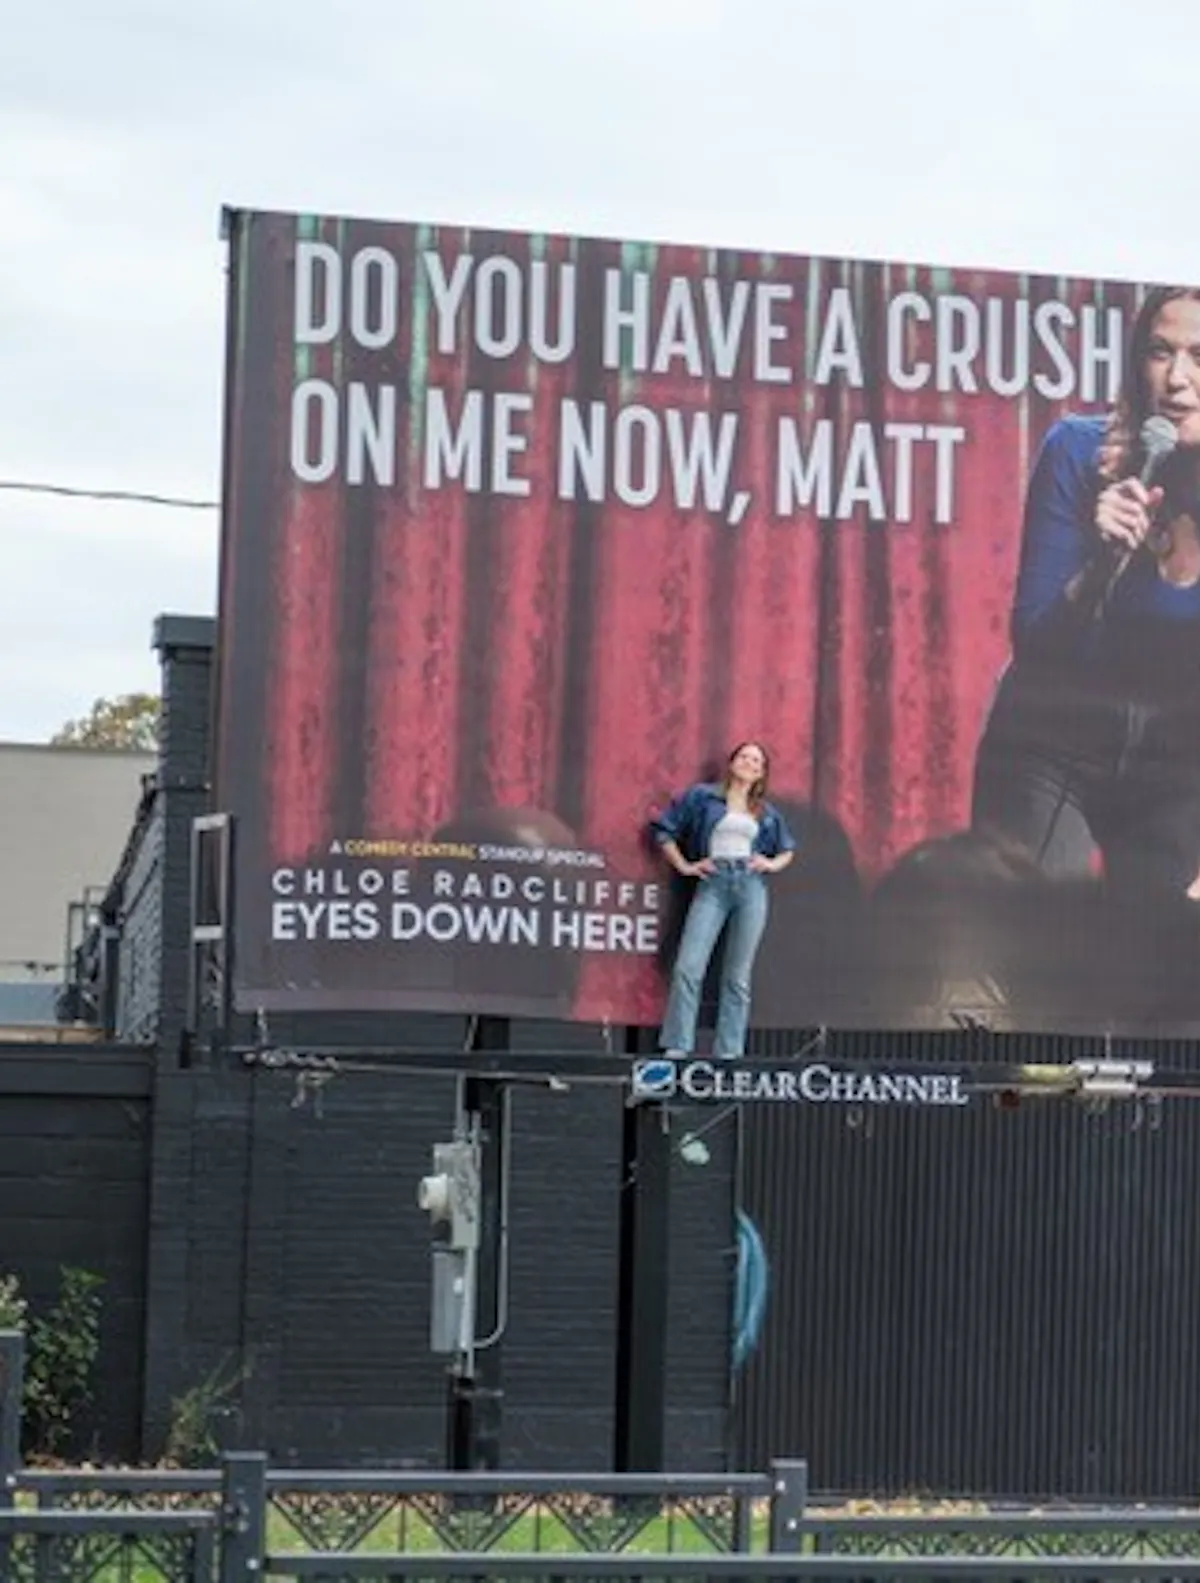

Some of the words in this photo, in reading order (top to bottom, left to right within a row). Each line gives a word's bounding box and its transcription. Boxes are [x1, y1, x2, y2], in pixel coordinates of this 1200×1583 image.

[295, 241, 397, 348] DO
[422, 251, 577, 363] YOU
[604, 269, 792, 381] HAVE
[815, 286, 863, 388] A
[887, 291, 1124, 402] CRUSH
[290, 380, 395, 485] ON
[425, 388, 530, 495] ME
[559, 399, 751, 526] NOW,
[776, 419, 964, 524] MATT
[329, 839, 342, 855] A
[344, 840, 408, 857] COMEDY
[411, 842, 477, 860] CENTRAL
[546, 849, 605, 868] SPECIAL
[272, 868, 409, 896] CHLOE
[434, 870, 659, 909] RADCLIFFE
[271, 901, 379, 941] EYES
[391, 903, 541, 945] DOWN
[552, 912, 659, 951] HERE
